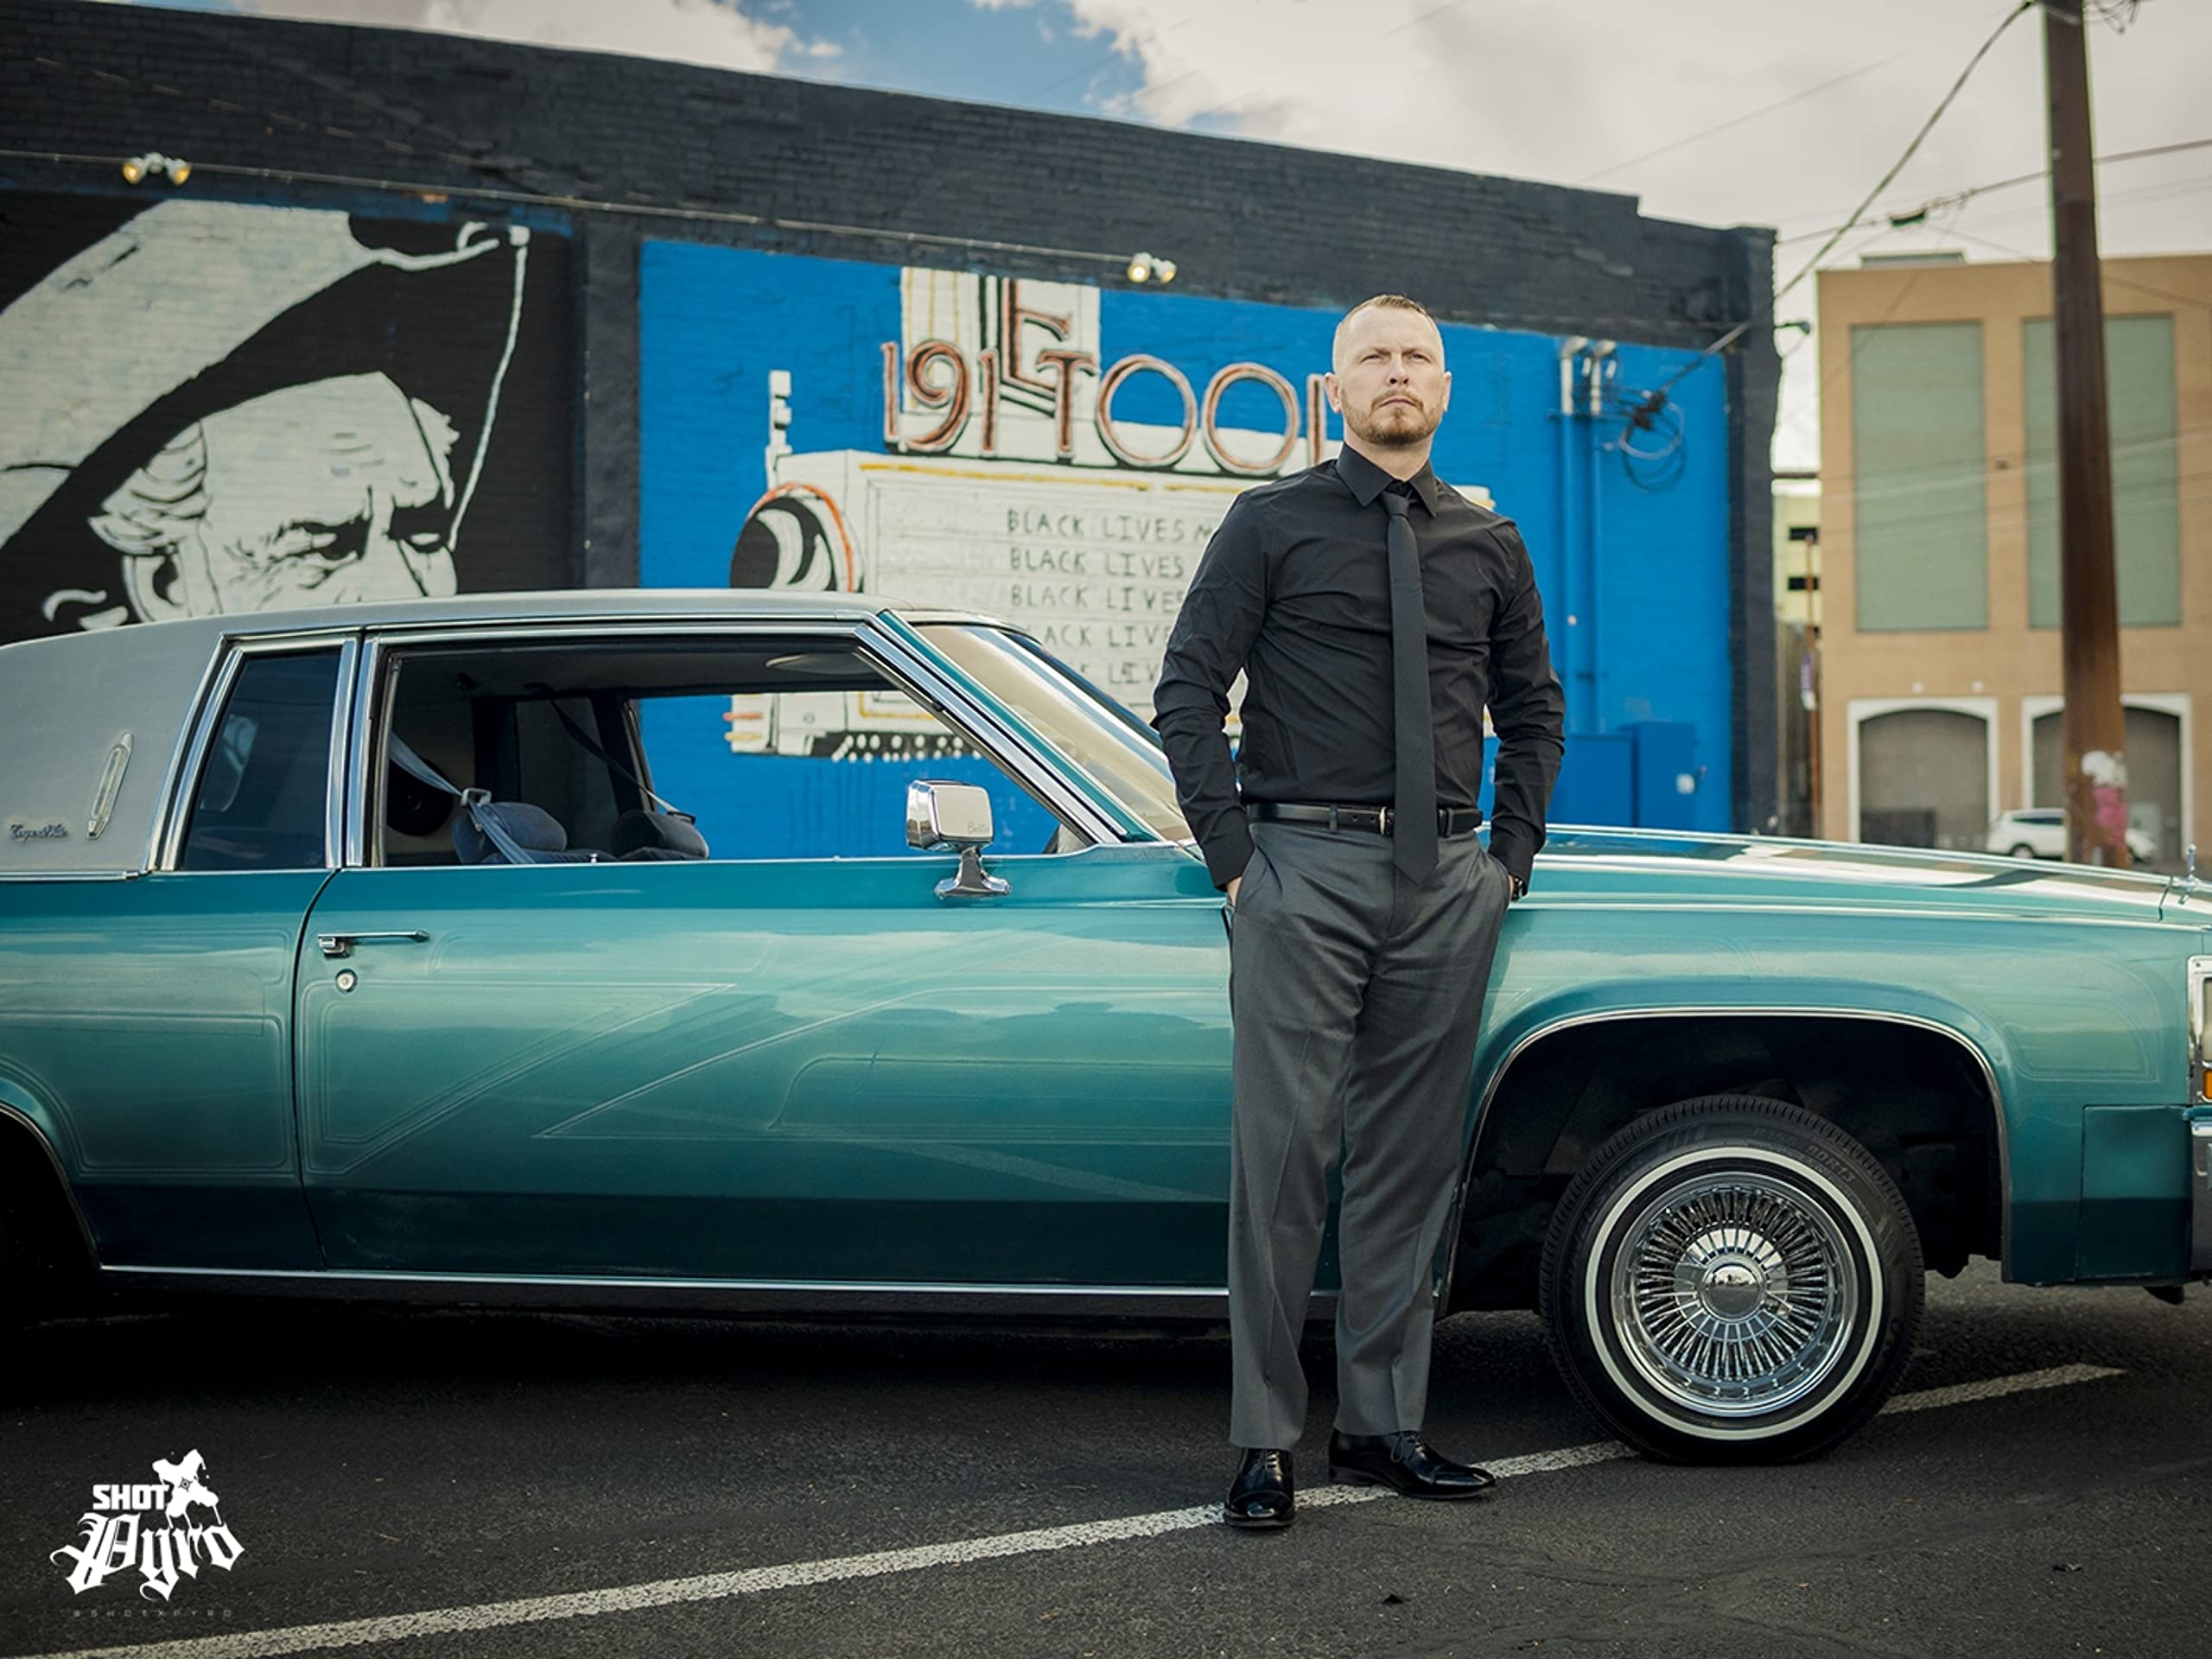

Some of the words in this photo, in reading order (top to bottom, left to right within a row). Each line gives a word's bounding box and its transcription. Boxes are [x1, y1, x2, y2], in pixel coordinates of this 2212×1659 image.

[1007, 509, 1086, 537] BLACK
[1103, 515, 1185, 542] LIVES
[1010, 547, 1086, 575] BLACK
[1104, 551, 1184, 579] LIVES
[1011, 584, 1089, 608] BLACK
